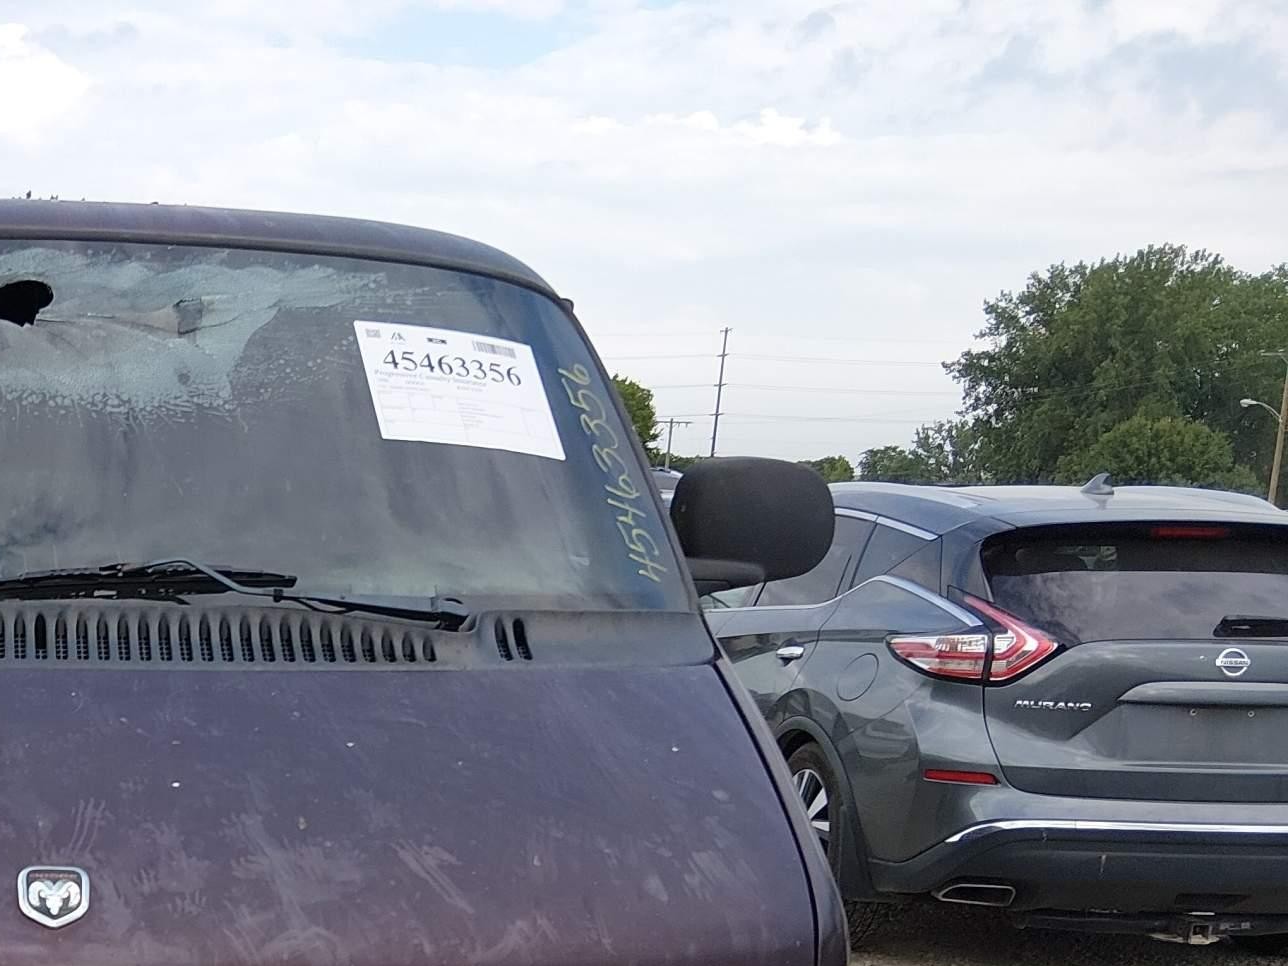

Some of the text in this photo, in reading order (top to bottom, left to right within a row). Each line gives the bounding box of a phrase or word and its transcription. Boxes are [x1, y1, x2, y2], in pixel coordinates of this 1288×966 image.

[383, 349, 522, 386] 45463356
[558, 363, 667, 583] 45463356
[1014, 700, 1092, 711] MURANO
